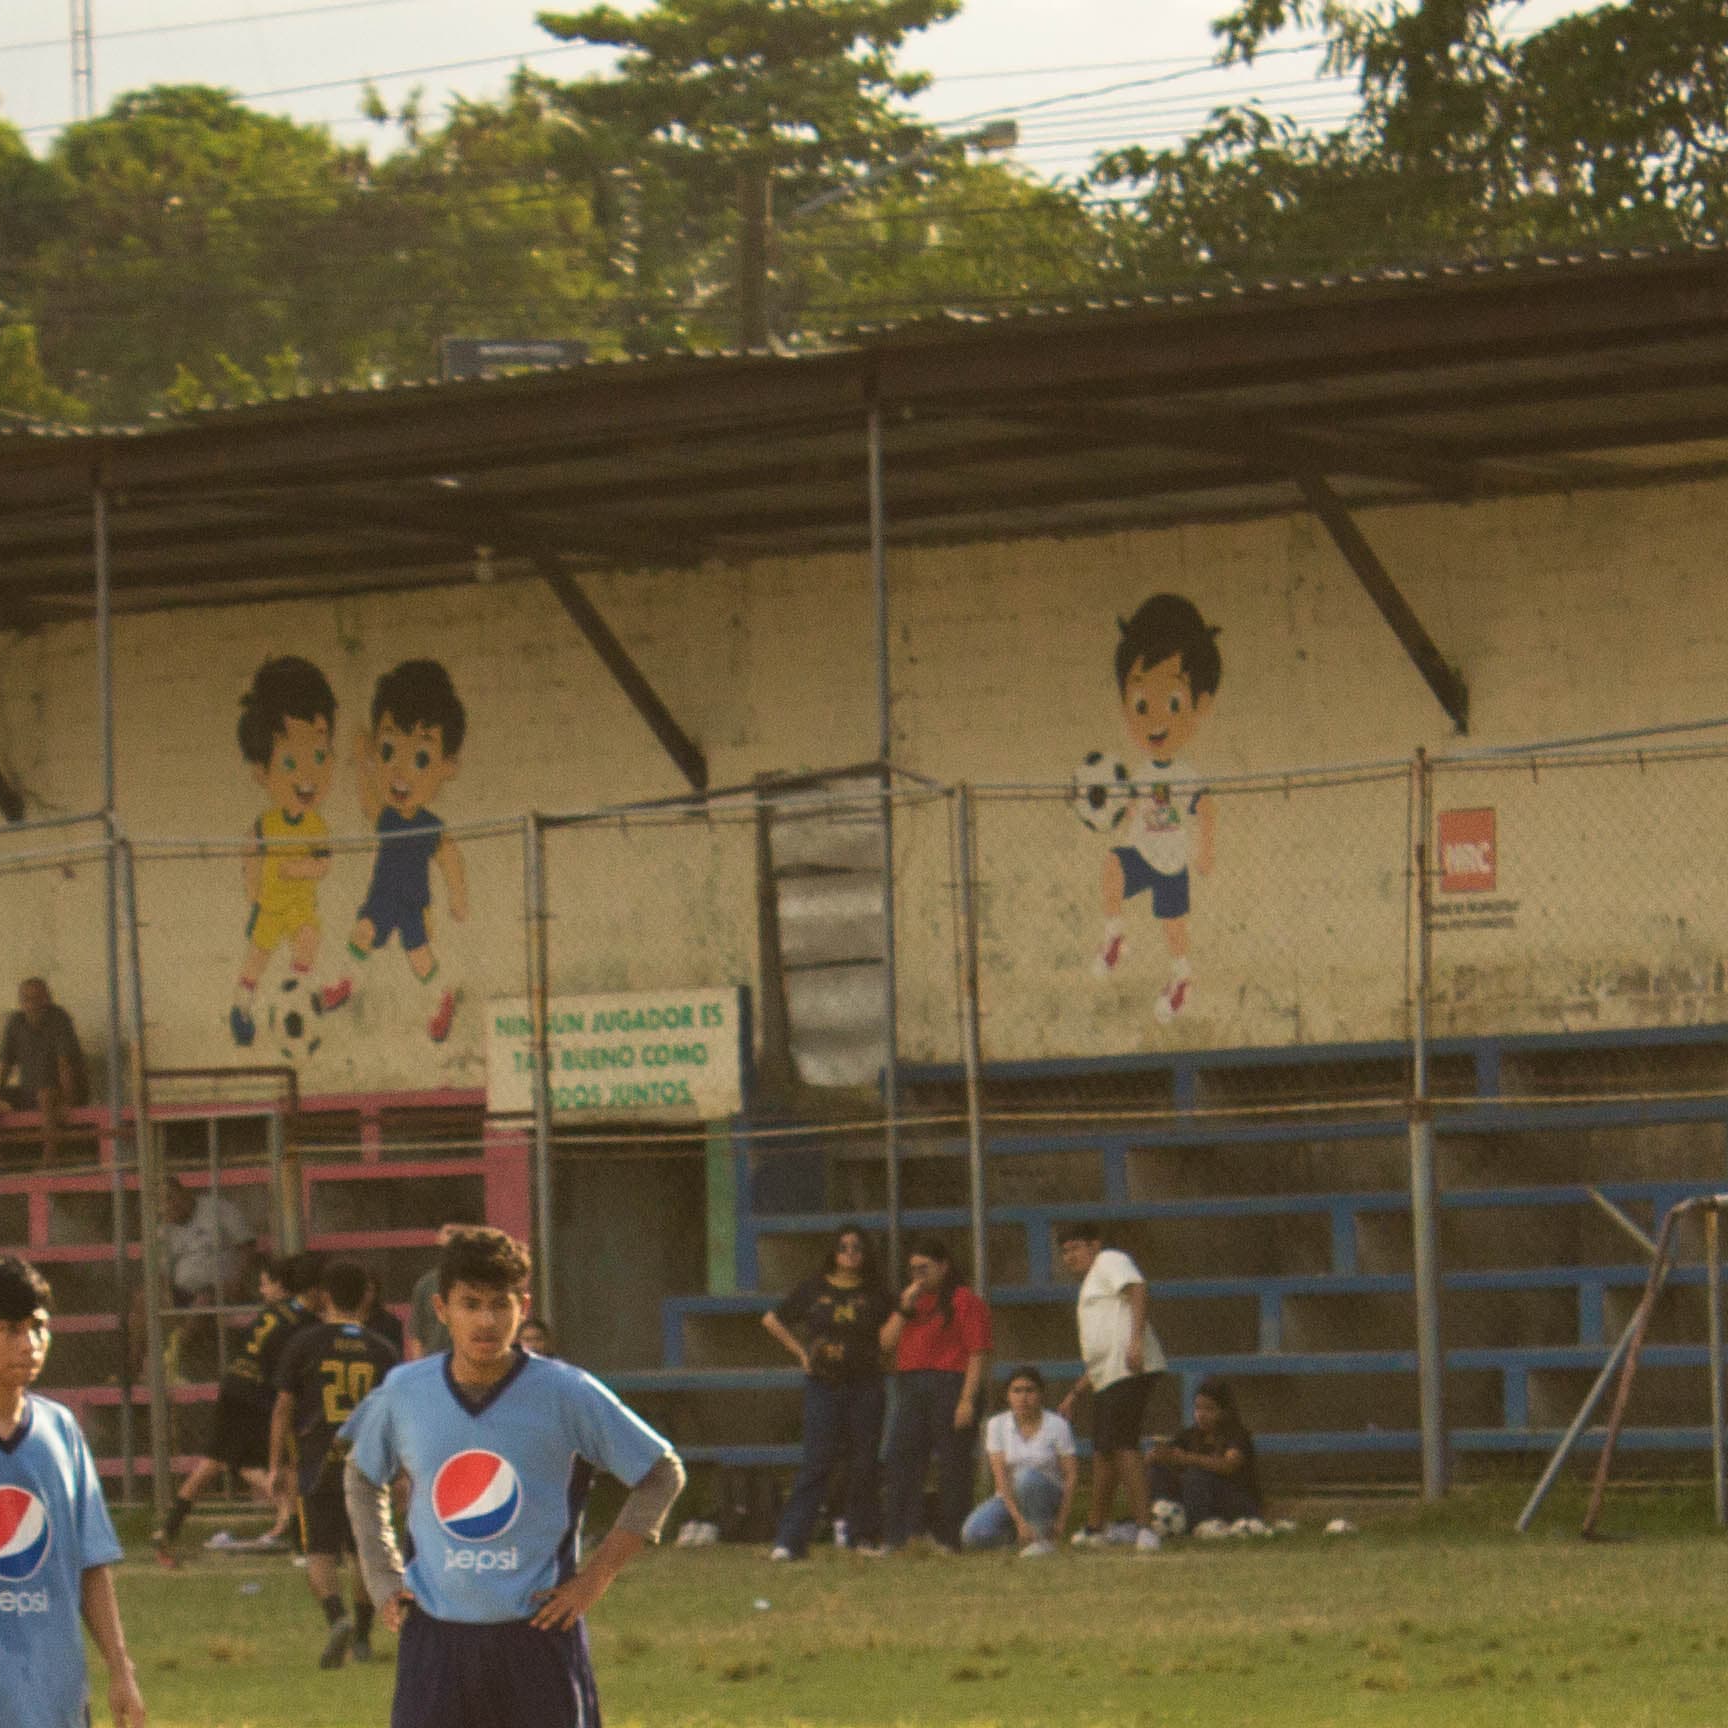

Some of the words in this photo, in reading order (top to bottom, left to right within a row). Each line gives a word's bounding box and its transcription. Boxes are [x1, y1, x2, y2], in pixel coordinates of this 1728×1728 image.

[591, 1004, 695, 1034] JUGADOR
[699, 1002, 725, 1029] ES
[560, 1045, 636, 1071] BUENO
[640, 1041, 710, 1068] COMO
[608, 1081, 693, 1106] JUNTOS
[319, 1359, 375, 1424] 20
